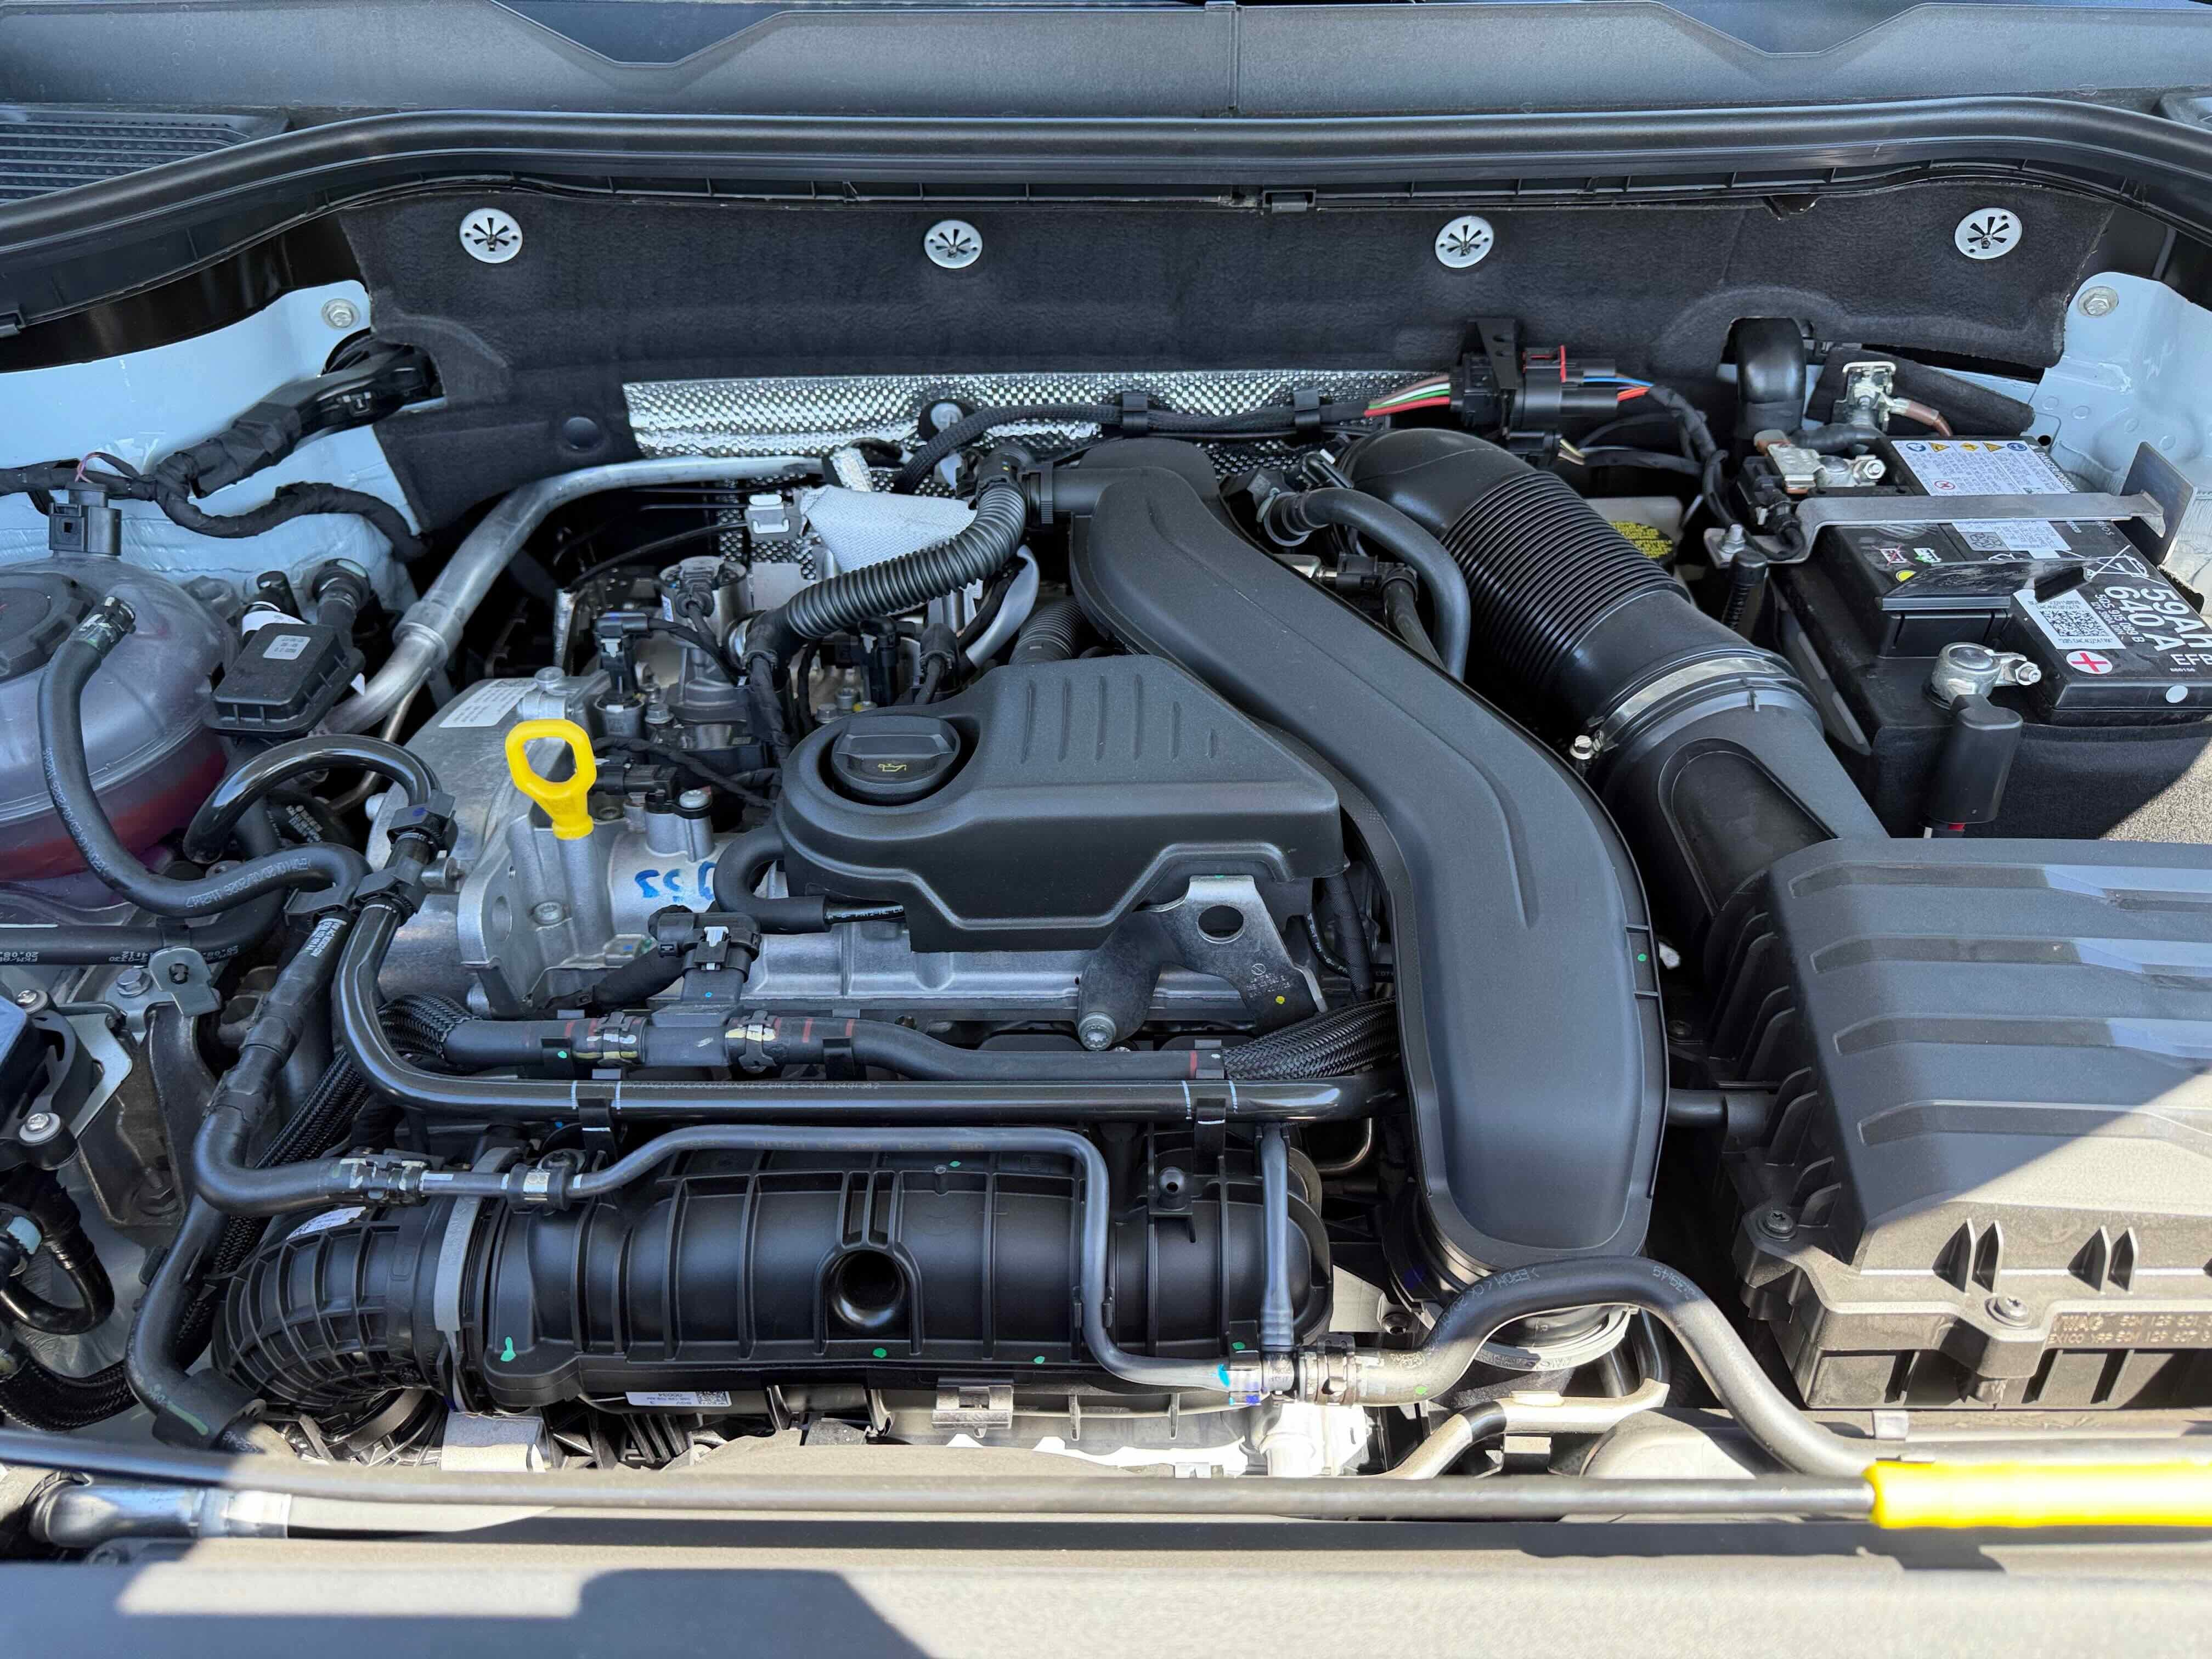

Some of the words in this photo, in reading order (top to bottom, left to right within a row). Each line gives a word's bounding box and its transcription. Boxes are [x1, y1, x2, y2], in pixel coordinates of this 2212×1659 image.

[2094, 594, 2115, 608] 5QS
[2108, 610, 2128, 621] 915
[2119, 622, 2139, 635] 089
[2104, 586, 2165, 627] 640
[2142, 632, 2186, 652] A
[2140, 588, 2212, 648] 59Ah
[2170, 653, 2212, 665] EFB
